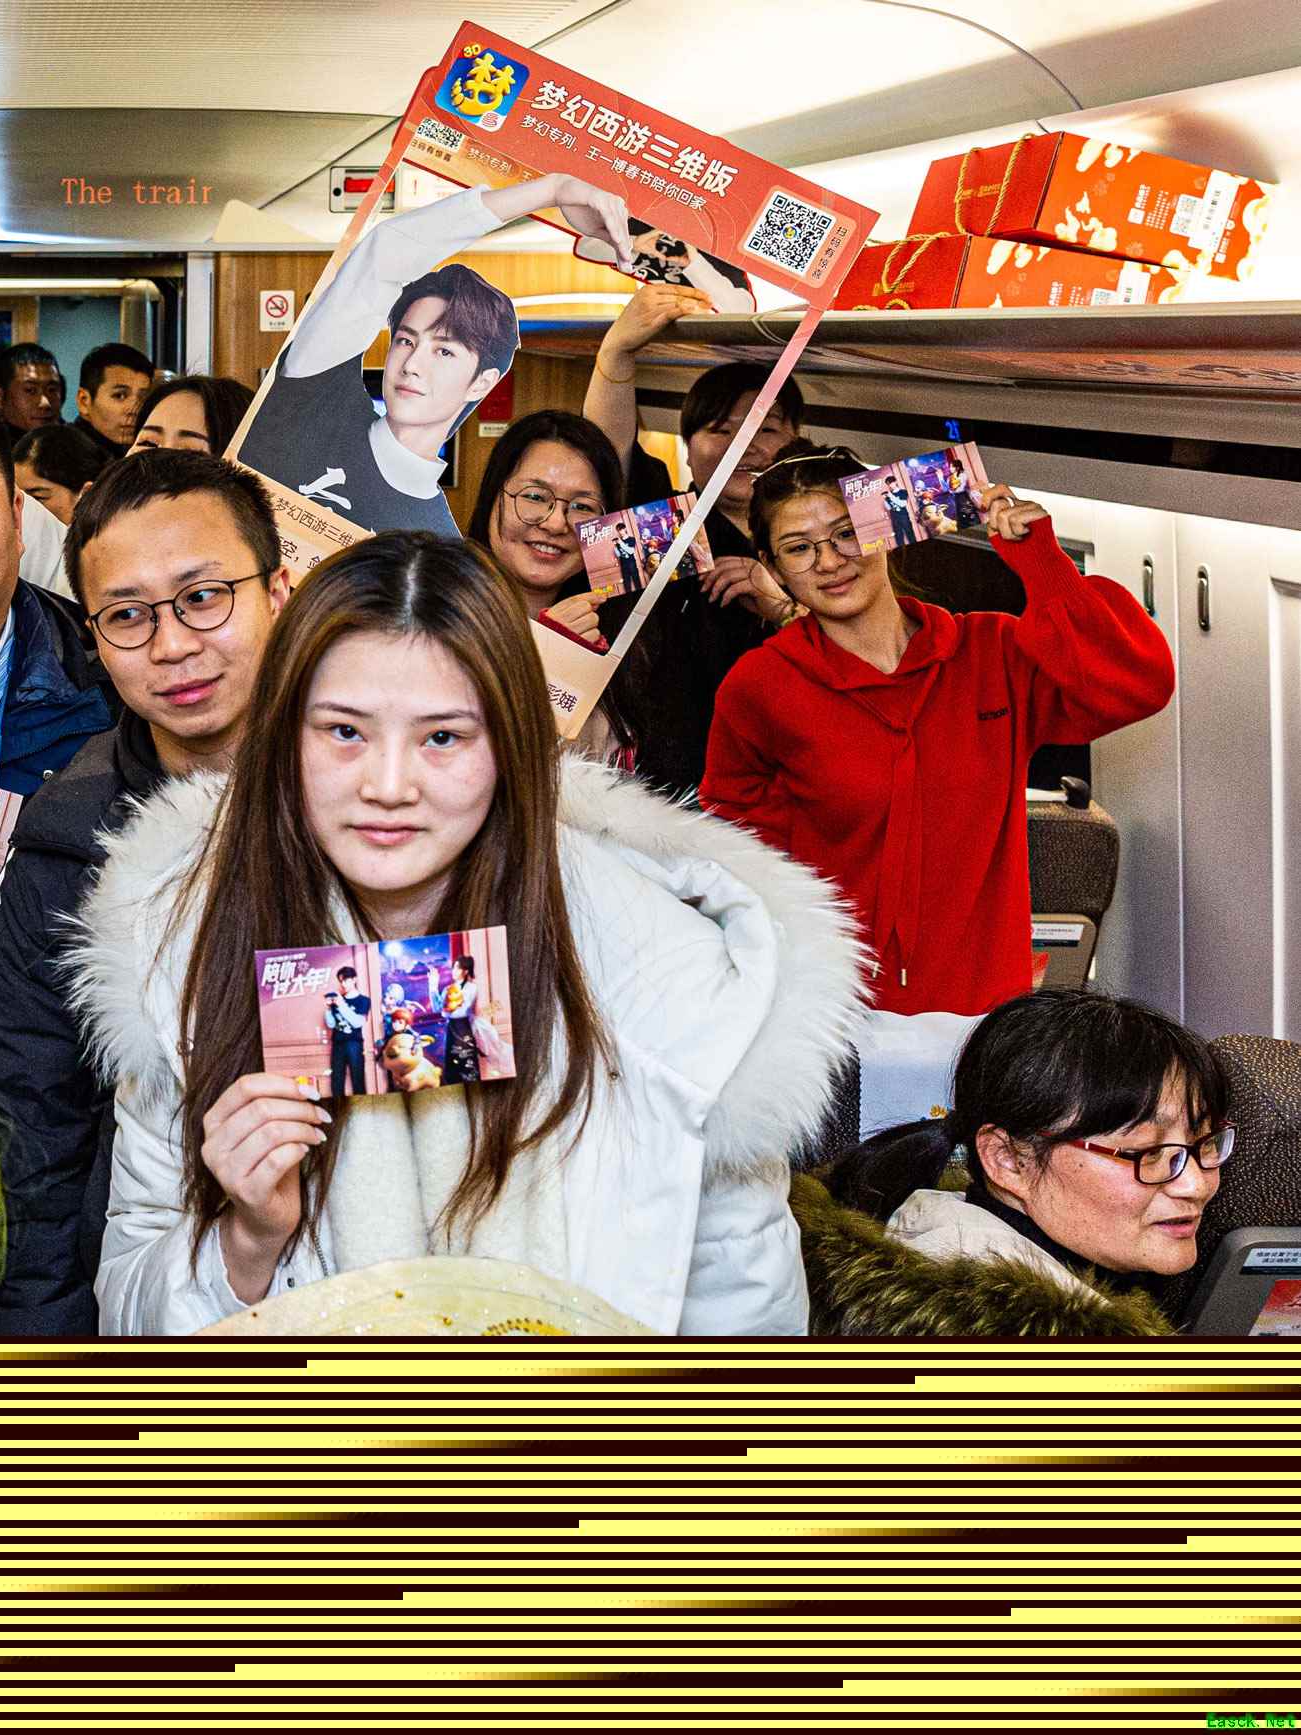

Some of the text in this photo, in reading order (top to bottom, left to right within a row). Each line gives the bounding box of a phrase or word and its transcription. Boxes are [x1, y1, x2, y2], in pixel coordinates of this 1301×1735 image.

[463, 43, 482, 58] 3D
[531, 80, 739, 197] 梦幻西游三维版
[60, 177, 113, 204] The
